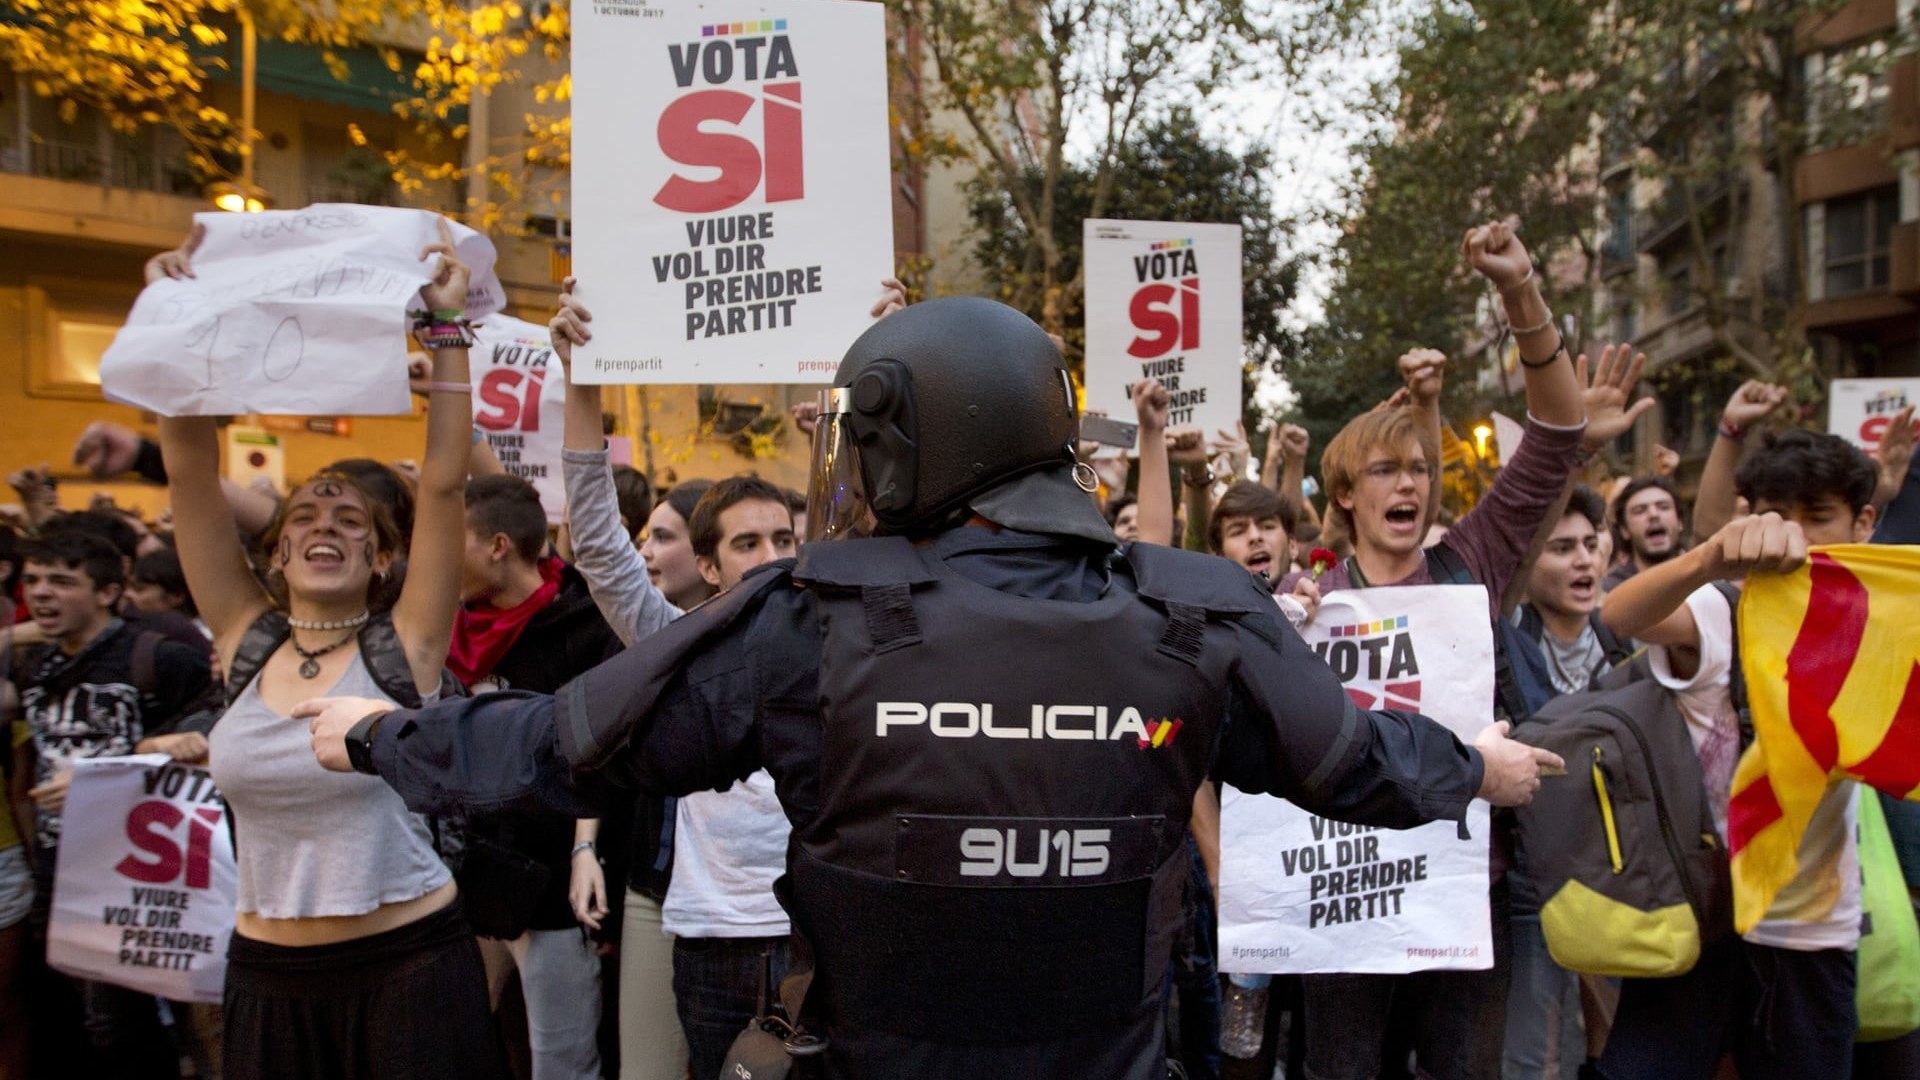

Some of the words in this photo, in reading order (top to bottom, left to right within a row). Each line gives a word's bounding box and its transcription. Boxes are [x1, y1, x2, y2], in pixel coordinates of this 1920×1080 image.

[667, 34, 799, 88] VOTA
[685, 211, 774, 248] VIURE
[652, 253, 710, 283] VOL
[715, 243, 766, 275] DIR
[1134, 248, 1199, 282] VOTA
[685, 265, 822, 310] PRENDRE
[686, 298, 797, 341] PARTIT
[491, 343, 552, 367] VOTA
[595, 356, 663, 373] #prenpartit
[798, 359, 841, 374] prenpa
[1142, 356, 1185, 378] VIURE
[1169, 387, 1206, 409] NDRE
[504, 464, 548, 479] NDRE
[876, 702, 1151, 741] POLICIA
[1309, 814, 1386, 842] VIU
[960, 827, 1112, 877] 9U15
[1281, 844, 1332, 877] VOL
[1336, 835, 1380, 868] DIR
[1310, 853, 1428, 901] PRENDRE
[132, 886, 190, 911] VIURE
[1309, 887, 1406, 930] PARTIT
[103, 904, 142, 928] VOL
[146, 909, 182, 930] DIR
[120, 928, 215, 954] PRENDRE
[1232, 945, 1290, 959] #prenpartit
[1407, 946, 1479, 959] prenpartit.cat
[119, 949, 197, 972] PARTIT
